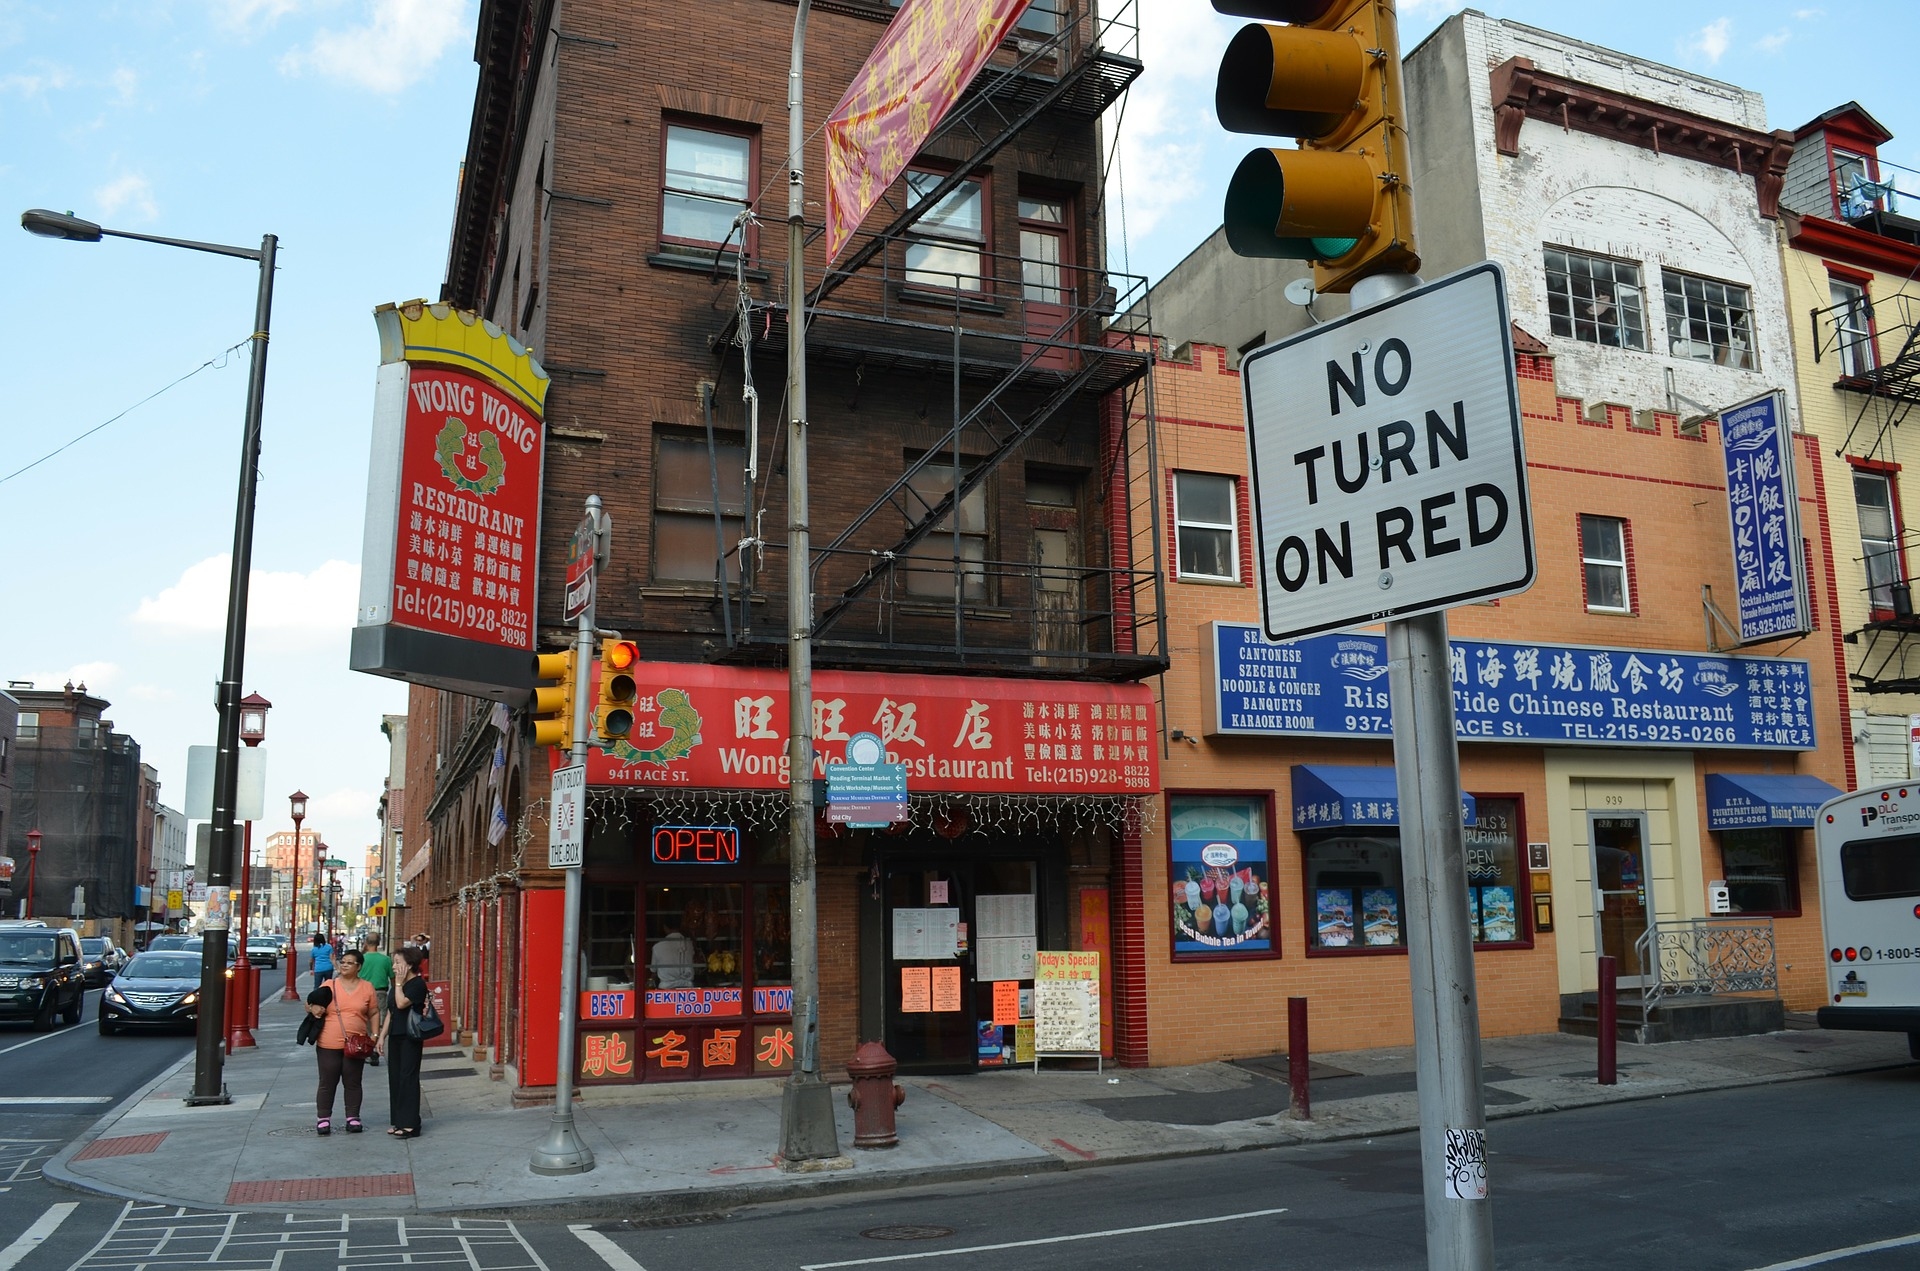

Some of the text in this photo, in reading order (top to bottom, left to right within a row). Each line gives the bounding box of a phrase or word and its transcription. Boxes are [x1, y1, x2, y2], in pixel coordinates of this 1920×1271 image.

[1326, 337, 1412, 416] NO
[411, 380, 537, 454] WONG WONG
[1294, 400, 1469, 506] TURN
[412, 481, 524, 539] RESTAURANT
[1275, 483, 1509, 593] ON RED
[408, 533, 462, 566] 美味小菜
[1765, 586, 1794, 602] Restaurant
[501, 607, 527, 628] 8822
[1743, 613, 1796, 638] 215-925-0266
[500, 627, 526, 647] 9898
[1239, 647, 1302, 663] CANTONESE
[1239, 664, 1297, 679] SZECHUAN
[1745, 662, 1805, 679] 游水海鮮
[1222, 679, 1321, 696] NOODLE & CONGEE
[1747, 678, 1807, 695] 廣東小炒
[640, 696, 656, 713] 旺
[1243, 697, 1303, 712] BANQUETS
[1344, 685, 1390, 709] Ris
[1509, 692, 1604, 717] Chinese
[1611, 697, 1734, 723] Restaurant
[1748, 696, 1808, 712] 酒吧宴會
[639, 721, 656, 738] 旺
[734, 694, 993, 750] 旺旺飯店
[1231, 713, 1315, 729] KARAOKE ROOM
[1456, 719, 1494, 735] ACE
[1502, 721, 1530, 736] St.
[1023, 722, 1082, 741] 美味小菜
[718, 747, 791, 784] Wong
[1124, 765, 1150, 776] 8822
[566, 770, 583, 788] BLOCK
[608, 769, 690, 782] 941 RACE ST.
[1124, 777, 1150, 788] 9898
[1605, 796, 1623, 805] 939
[1726, 798, 1744, 806] K.T.V.
[1878, 803, 1899, 815] DLC
[1712, 806, 1767, 817] PRIVATE PARTY ROOM
[1770, 806, 1792, 822] Rising
[1792, 806, 1806, 819] Tide
[1713, 816, 1767, 825] 215-925-0266
[551, 843, 580, 863] THE BOX
[654, 829, 735, 861] OPEN
[1179, 919, 1195, 939] Best
[1195, 931, 1221, 947] Bubble
[1222, 936, 1236, 947] Tea
[1237, 934, 1244, 943] in
[1037, 952, 1098, 969] Today's Special
[591, 993, 624, 1017] BEST
[645, 989, 741, 1004] PEKING DUCK
[753, 989, 793, 1012] IN TOW
[675, 1003, 712, 1015] FOOD
